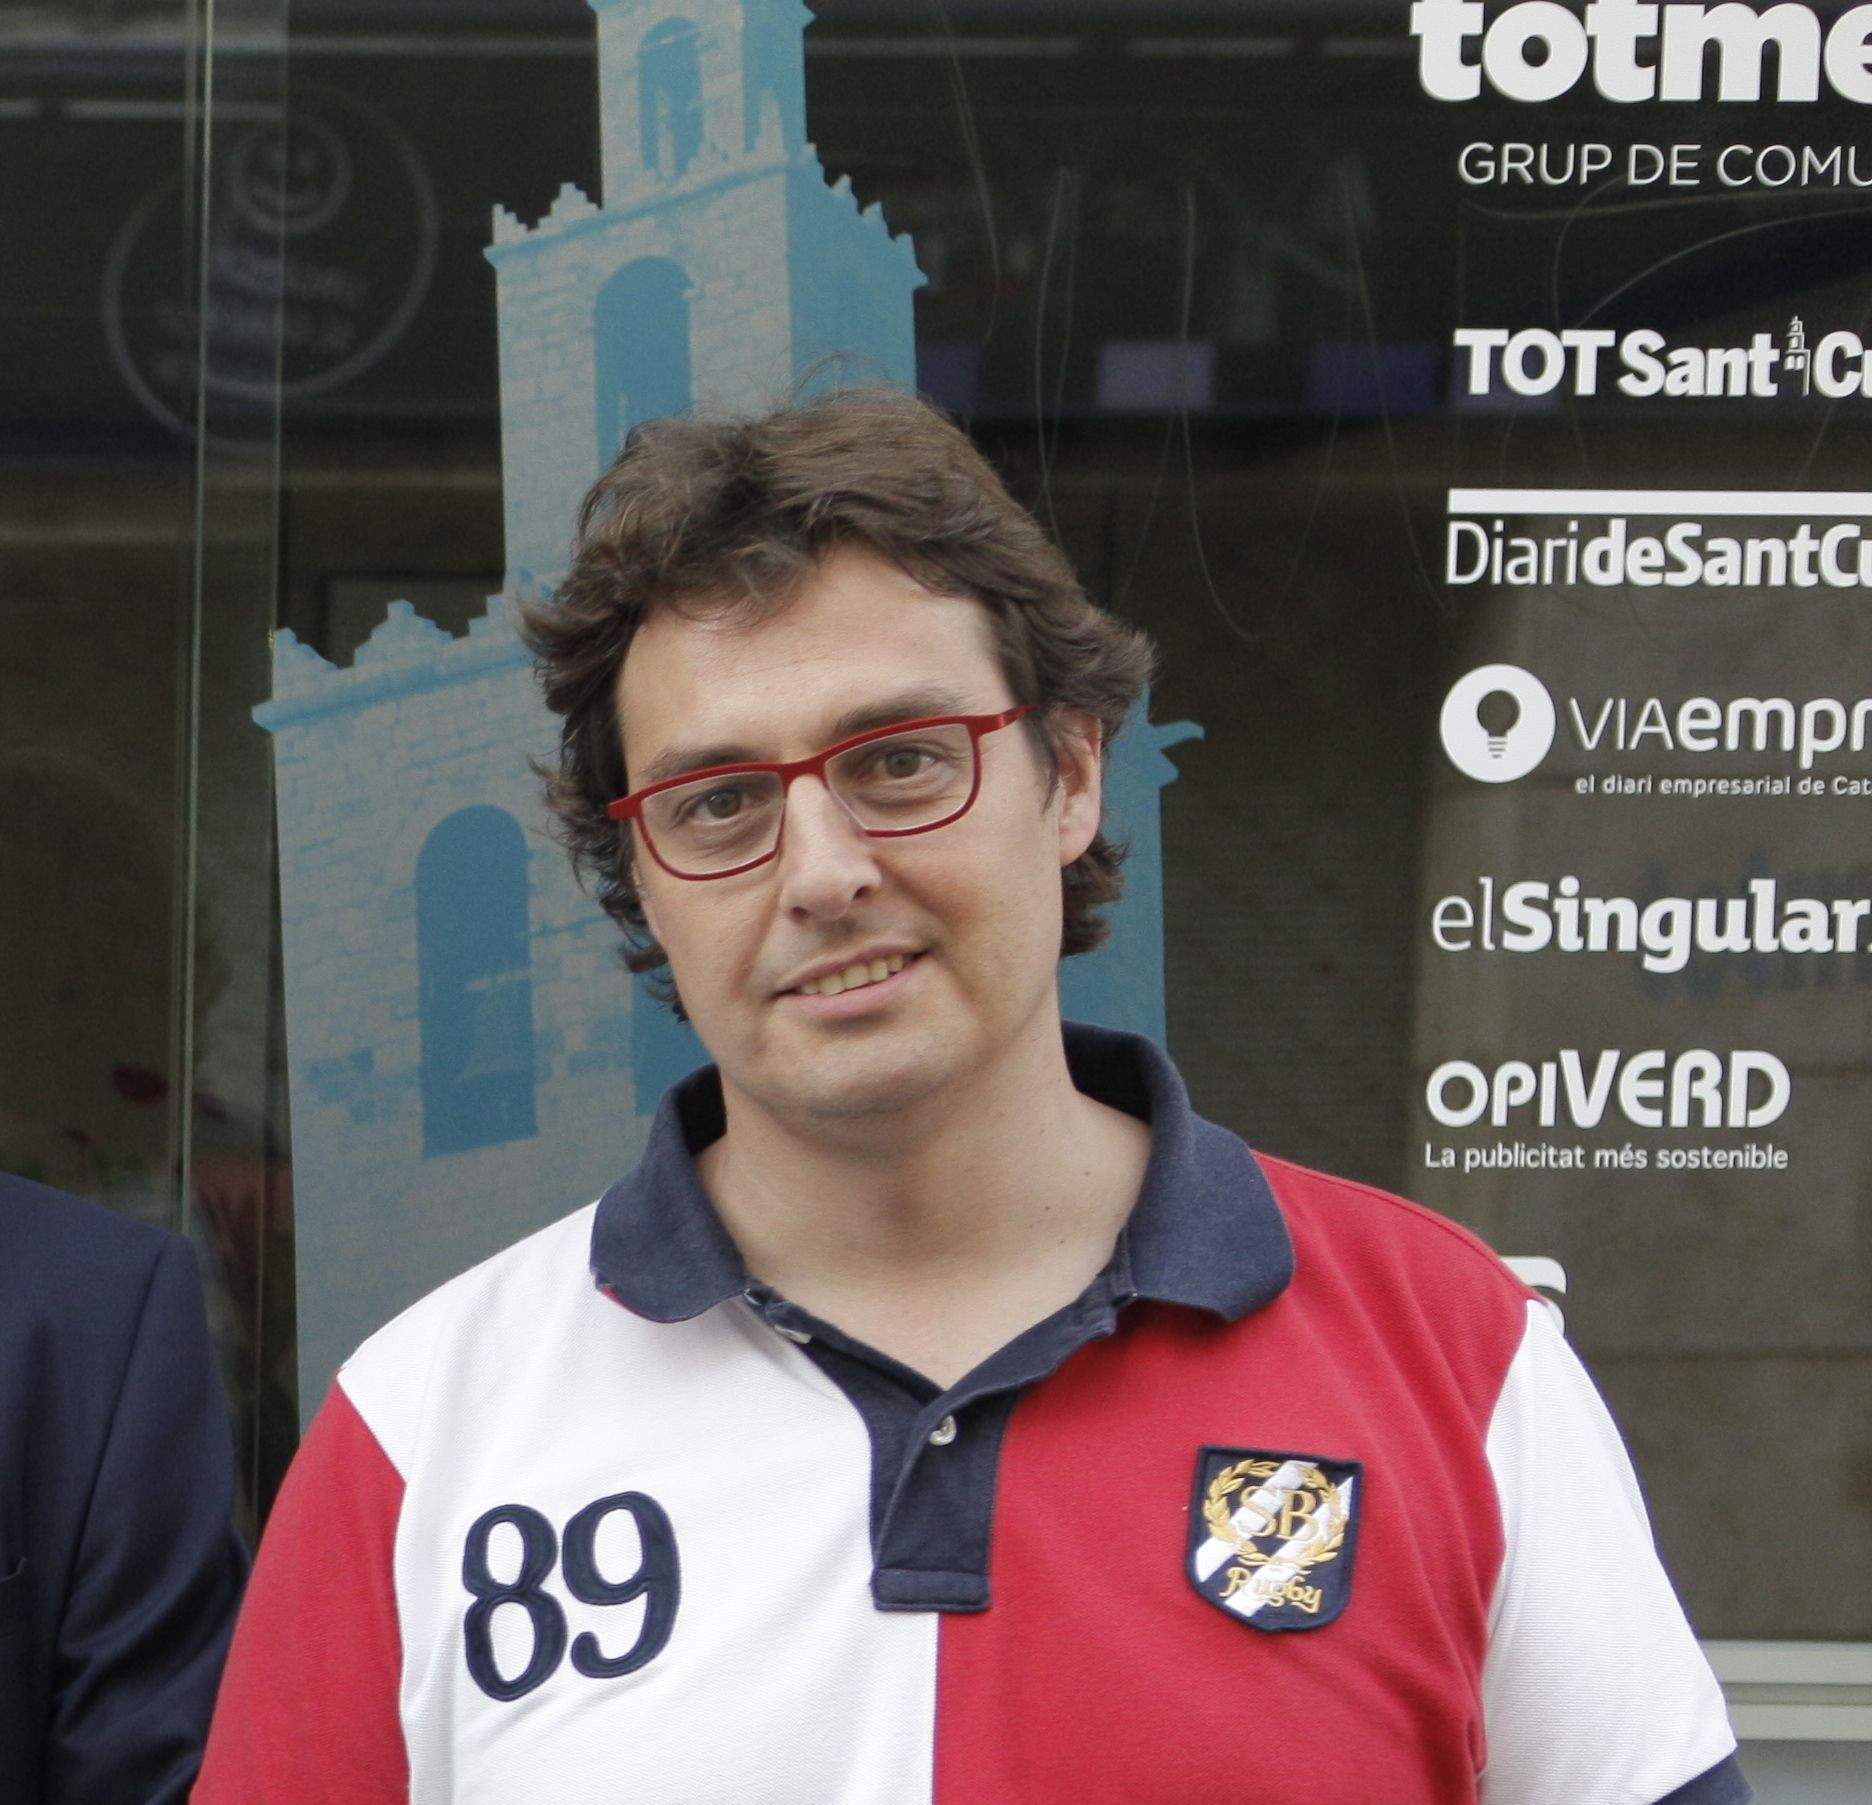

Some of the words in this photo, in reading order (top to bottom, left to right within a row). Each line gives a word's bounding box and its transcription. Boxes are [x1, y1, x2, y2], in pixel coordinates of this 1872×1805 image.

[1458, 142, 1612, 185] GRUP
[1627, 143, 1702, 186] DE
[1812, 330, 1872, 398] C
[1574, 775, 1595, 794] el
[1601, 774, 1652, 795] diari
[1658, 775, 1791, 798] empresarial
[1797, 775, 1826, 795] de
[1431, 875, 1872, 974] elSingular
[1424, 1142, 1456, 1169] La
[1463, 1142, 1586, 1174] publicitat
[1593, 1142, 1648, 1170] més
[1655, 1142, 1789, 1170] sostenible
[1240, 1484, 1320, 1542] SB
[461, 1490, 682, 1703] 89
[1218, 1567, 1324, 1615] Rugby
